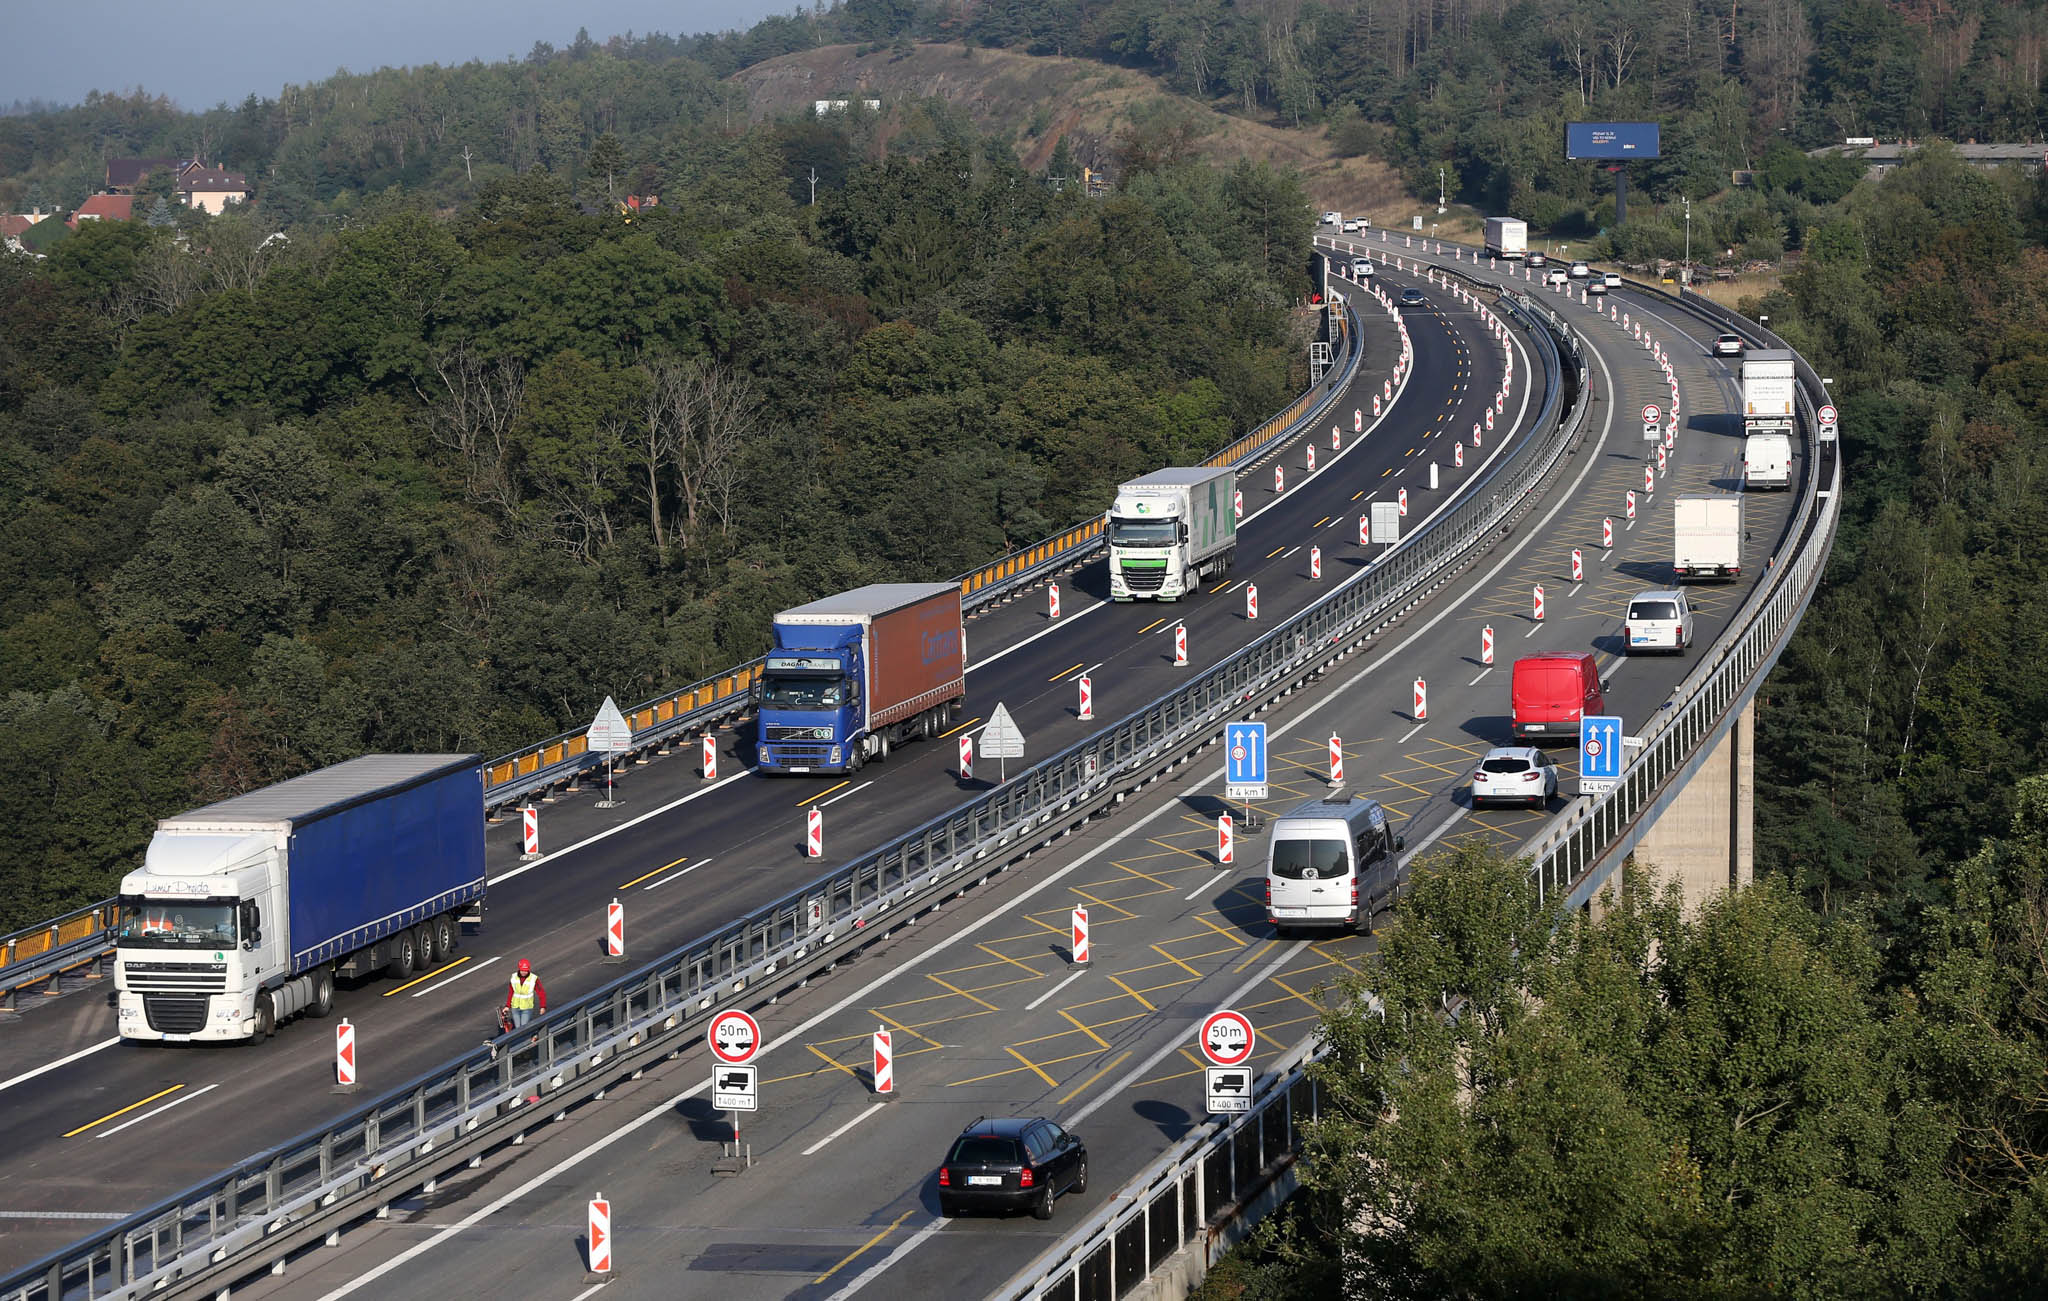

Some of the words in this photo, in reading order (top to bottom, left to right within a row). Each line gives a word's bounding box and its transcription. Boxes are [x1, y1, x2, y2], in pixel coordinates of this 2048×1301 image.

[1588, 782, 1594, 791] 4
[1597, 782, 1611, 791] km
[1235, 787, 1241, 796] 4
[1244, 787, 1258, 796] km
[720, 1024, 735, 1037] 50
[736, 1027, 748, 1037] m
[1212, 1025, 1228, 1038] 50
[1229, 1028, 1242, 1038] m
[723, 1098, 737, 1106] 400
[1217, 1100, 1232, 1109] 400
